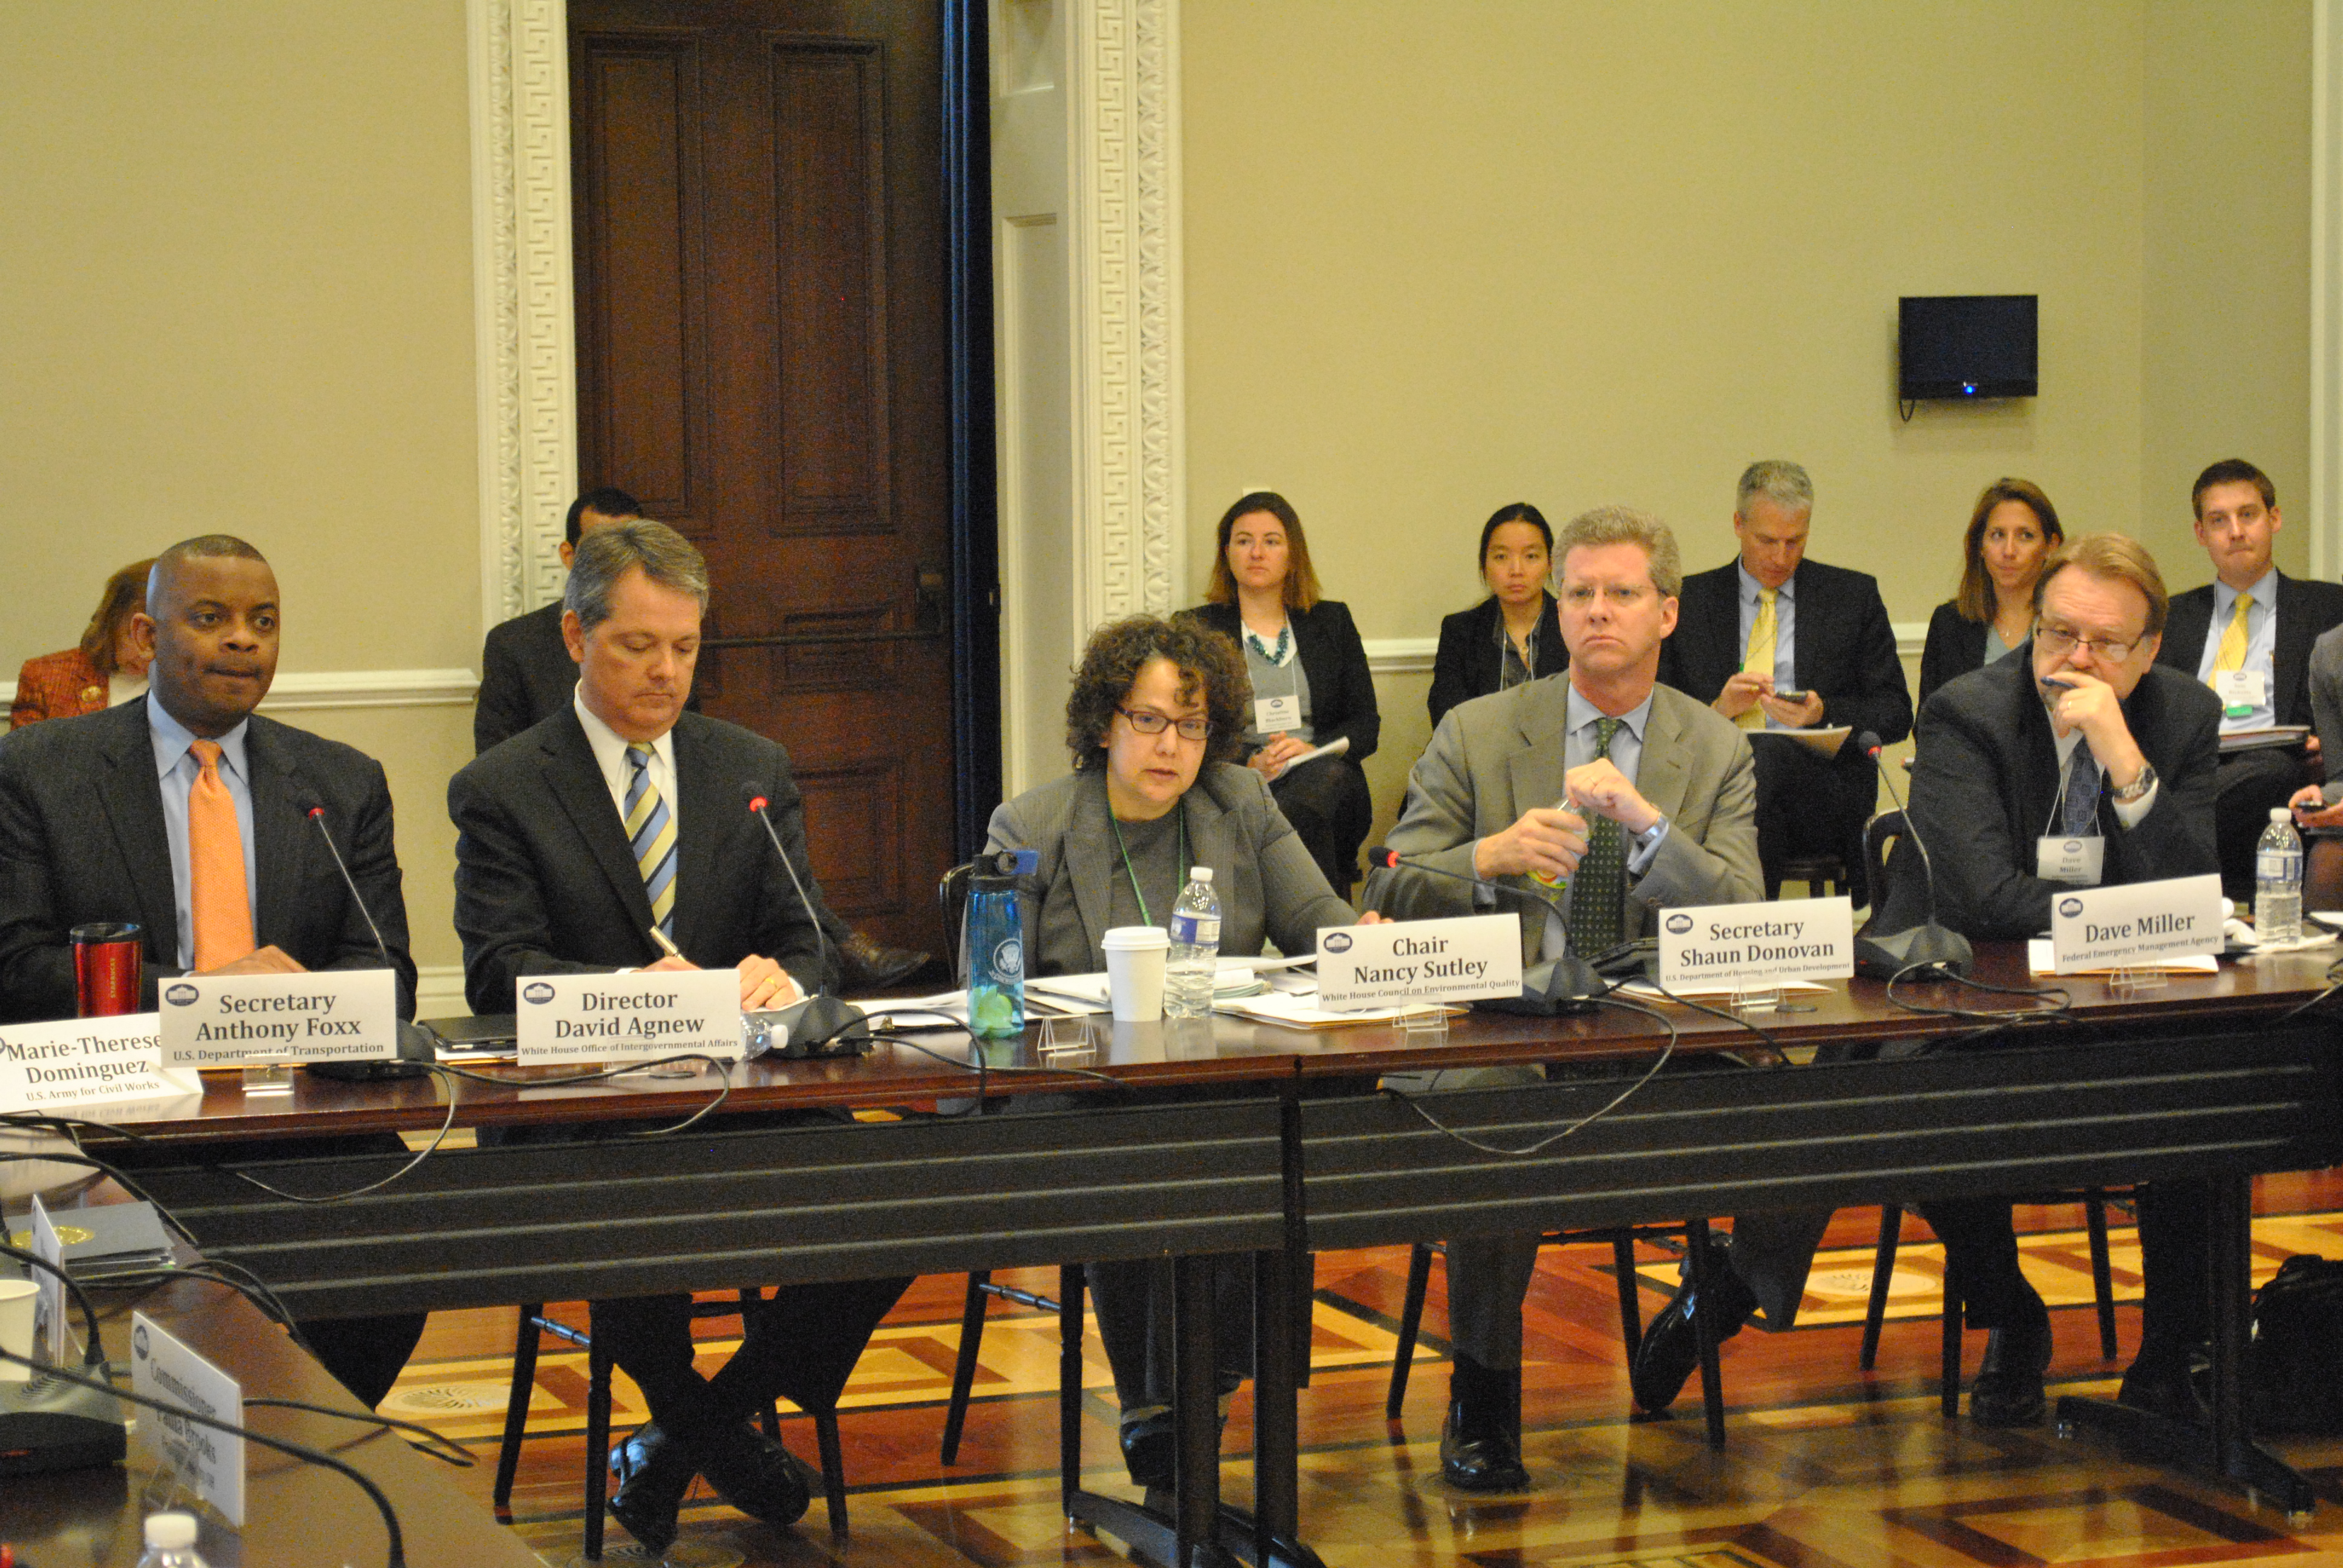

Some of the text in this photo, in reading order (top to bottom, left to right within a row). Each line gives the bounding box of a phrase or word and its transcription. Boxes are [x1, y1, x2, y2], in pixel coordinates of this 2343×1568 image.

[1709, 920, 1804, 941] Secretary
[2085, 913, 2195, 943] Dave Miller
[1392, 936, 1449, 957] Chair
[1680, 942, 1834, 967] Shaun Donovan
[2062, 935, 2219, 962] Federal Emergency Management Agency
[1354, 958, 1489, 984] Nancy Sutley
[1680, 972, 1722, 982] Department
[1733, 969, 1763, 977] Housing
[1803, 962, 1850, 972] Development
[582, 991, 678, 1011] Director
[1322, 993, 1348, 1002] White
[1349, 990, 1376, 1000] House
[1378, 987, 1409, 997] Council
[1424, 981, 1487, 994] Environmental
[1489, 979, 1521, 988] Quality
[219, 994, 337, 1015] Secretary
[195, 1018, 362, 1042] Anthony Foxx
[555, 1016, 705, 1039] David Agnew
[6, 1034, 161, 1062] Marie-Therese
[173, 1044, 384, 1062] U.S. Department of Transportation
[521, 1039, 738, 1056] White House Office of Intergovernmental Affairs
[25, 1060, 149, 1084] Dominguez
[26, 1080, 160, 1101] U.S. Army for Civil Works
[151, 1357, 217, 1418] Commissioner
